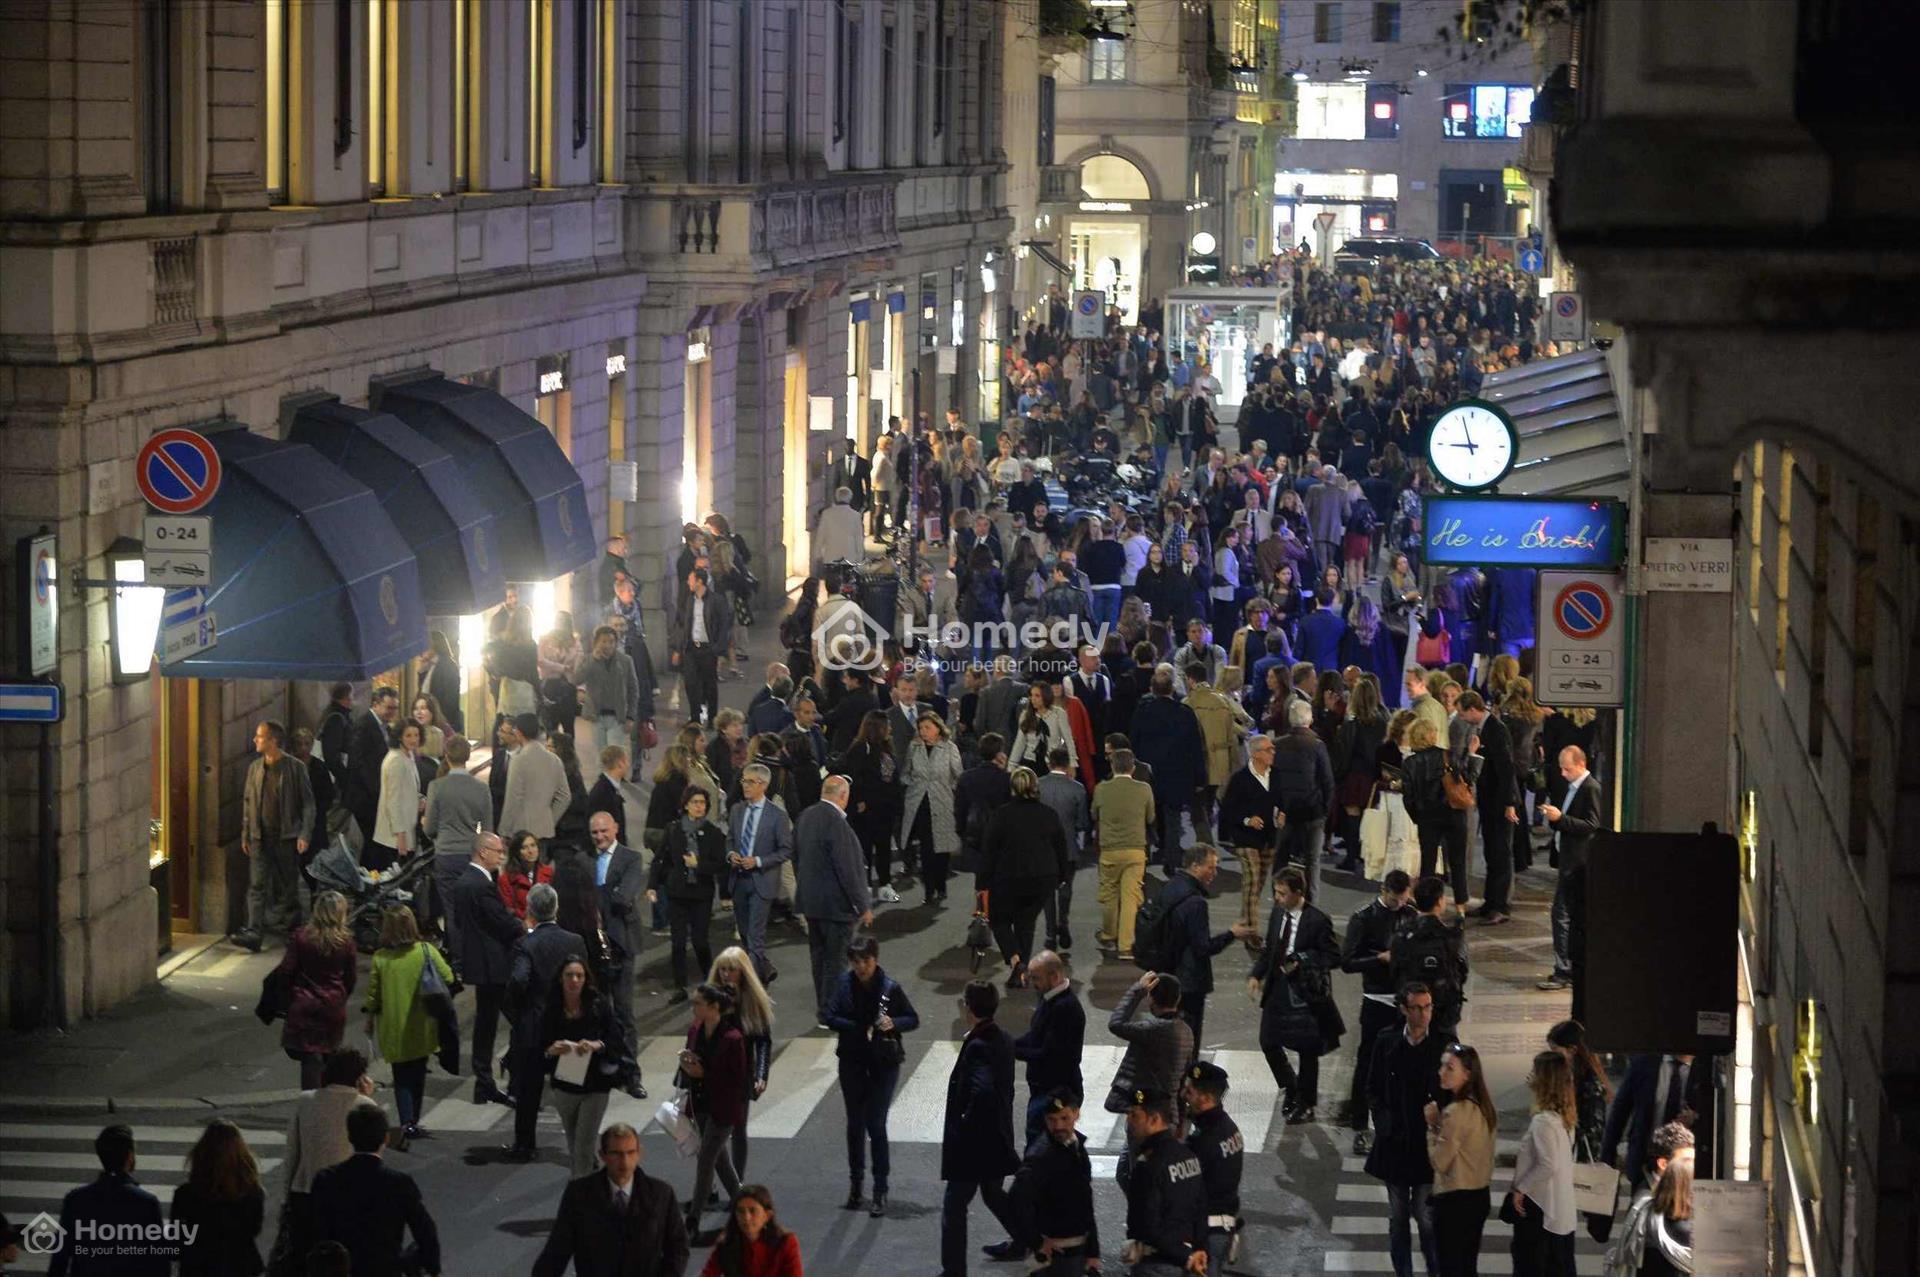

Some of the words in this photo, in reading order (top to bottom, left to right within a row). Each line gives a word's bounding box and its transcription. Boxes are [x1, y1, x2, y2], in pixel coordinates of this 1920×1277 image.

[156, 527, 197, 540] 0-24
[1432, 518, 1472, 546] He
[1481, 528, 1509, 547] is
[1680, 543, 1699, 552] VIA
[1690, 561, 1729, 573] VERRI
